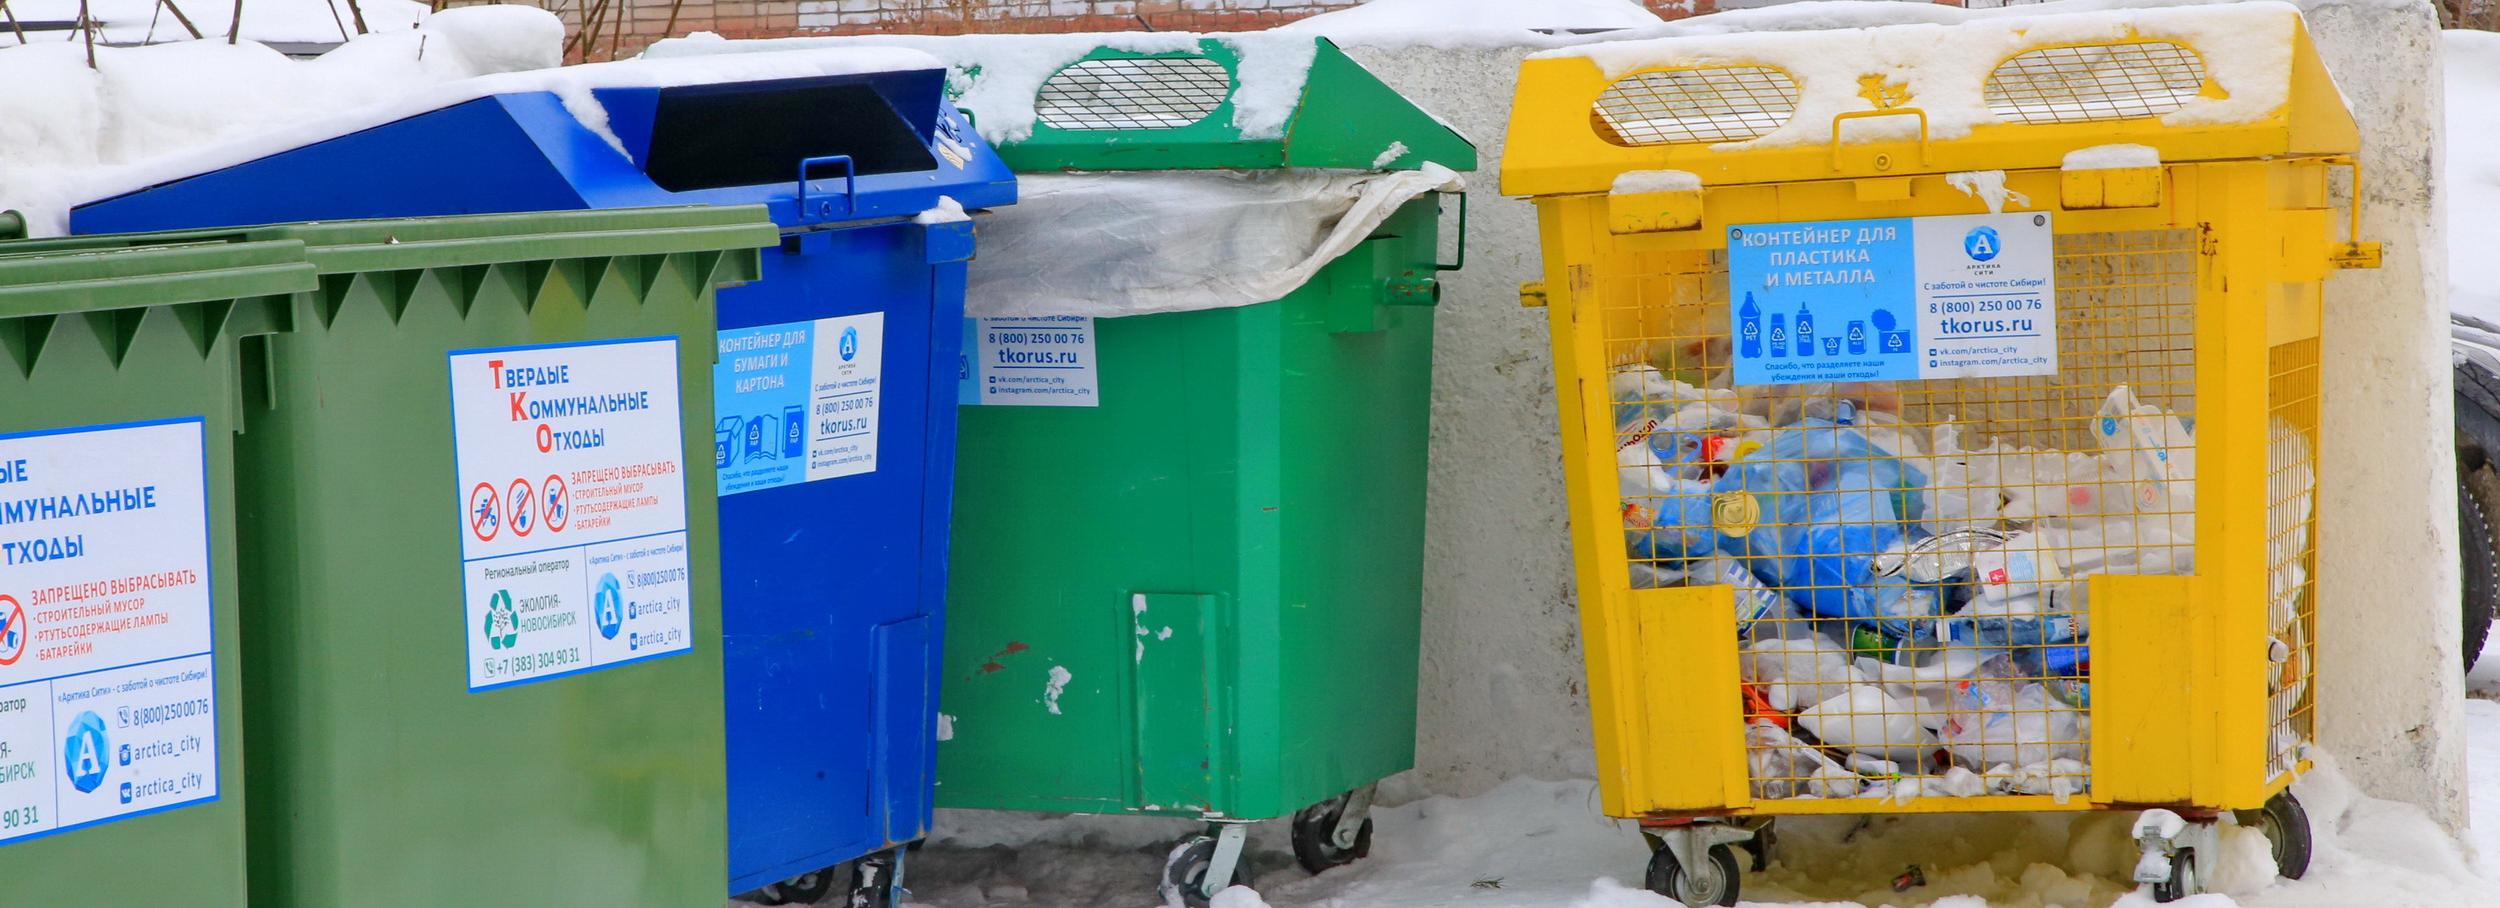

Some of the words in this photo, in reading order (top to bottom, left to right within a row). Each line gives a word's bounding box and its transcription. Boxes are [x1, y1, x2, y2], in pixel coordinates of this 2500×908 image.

[1743, 227, 1851, 248] КОНТЕЙНЕР
[1856, 226, 1896, 245] ДЛЯ
[1771, 249, 1871, 266] ПЛАСТИКА
[1767, 273, 1779, 287] И
[1786, 269, 1876, 287] МЕТАЛЛА
[1931, 280, 1966, 290] заботой
[2010, 278, 2046, 290] Сибири!
[1930, 303, 1937, 314] 8
[1941, 301, 1975, 315] (800)
[1979, 300, 2003, 312] 250
[2007, 300, 2022, 311] 00
[2027, 299, 2042, 310] 76
[1941, 317, 2032, 334] tkorus.ru
[720, 332, 781, 353] КОНТЕЙНЕР
[783, 330, 805, 349] ДЛЯ
[989, 333, 996, 344] 8
[999, 332, 1028, 346] (800)
[1031, 333, 1051, 344] 250
[1054, 333, 1068, 344] 00
[1071, 333, 1085, 344] 76
[998, 348, 1077, 363] tkorus.ru
[1940, 345, 2018, 355] vk.com/arctica_city
[735, 354, 778, 373] БУМАГИ
[781, 352, 789, 367] И
[1765, 362, 1800, 371] Спасибо,
[1817, 361, 1860, 370] разделяете
[1940, 355, 2048, 368] instagram.com/arctica_city
[736, 374, 784, 393] КАРТОНА
[998, 375, 1065, 384] vk.com/arctica_city
[1771, 373, 1816, 382] убеждения
[1847, 370, 1879, 379] отходы!
[998, 385, 1091, 395] instagram.com/arctica_city
[816, 404, 821, 415] 8
[822, 401, 839, 417] (800)
[841, 400, 853, 412] 250
[855, 398, 863, 410] 00
[865, 397, 873, 408] 76
[820, 416, 867, 435] tkorus.ru
[571, 467, 620, 485] ЗАПРЕЩЕНО
[622, 461, 676, 479] ВЫБРАСЫВАТЬ
[624, 482, 643, 493] МУСОР
[0, 486, 156, 525] МУНАЛЬНЫЕ
[636, 496, 658, 507] ЛАМПЫ
[484, 564, 537, 580] Региональный
[538, 559, 570, 575] оператор
[32, 581, 107, 606] ЗАПРЕЩЕНО
[111, 569, 197, 596] ВЫБРАСЫВАТЬ
[114, 597, 145, 613] МУСОР
[520, 594, 561, 613] ЭКОЛОГИЯ-
[638, 596, 680, 615] arctica_city
[134, 612, 168, 628] ЛАМПЫ
[521, 611, 576, 633] НОВОСИБИРСК
[639, 627, 682, 645] arctica_city
[497, 658, 509, 674] +7
[511, 655, 536, 676] (383)
[538, 652, 555, 669] 304
[557, 650, 567, 665] 90
[569, 647, 580, 662] 31
[121, 677, 148, 693] заботой
[135, 735, 201, 758] arctica_city
[135, 771, 202, 799] arctica_city
[3, 808, 19, 829] 90
[23, 805, 39, 825] 31
